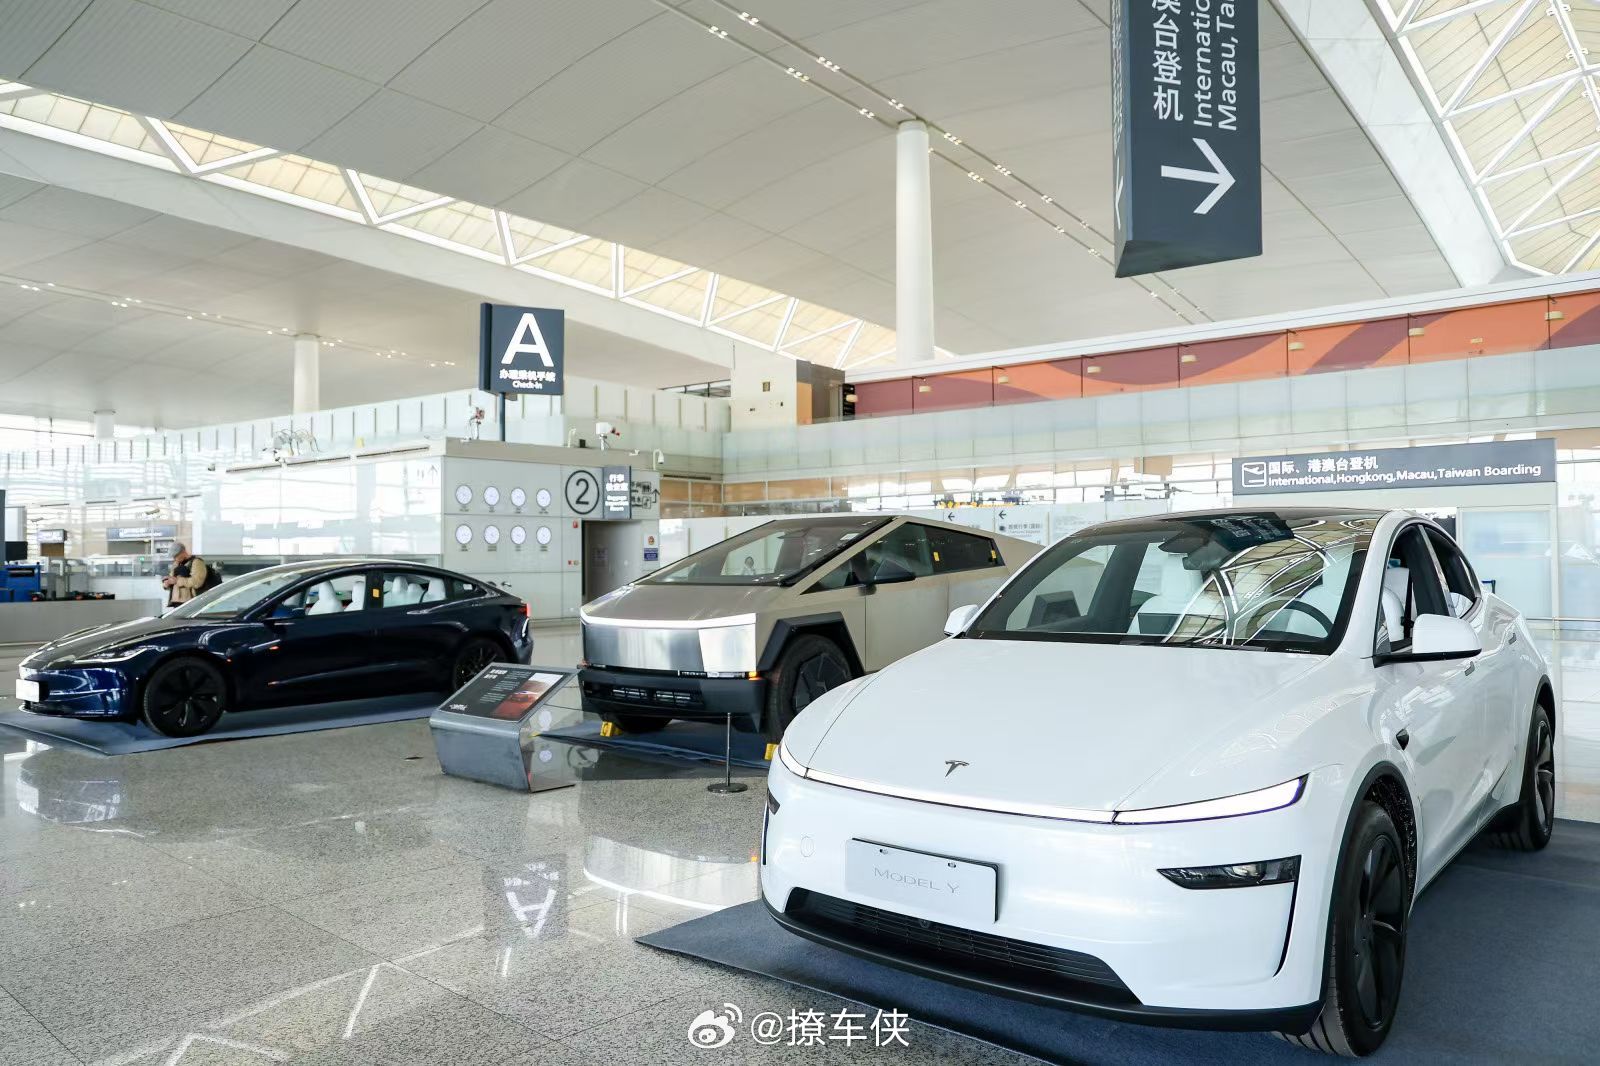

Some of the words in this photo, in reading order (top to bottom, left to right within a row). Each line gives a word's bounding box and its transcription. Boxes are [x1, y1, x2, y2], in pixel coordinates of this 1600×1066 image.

[501, 313, 554, 367] A
[1484, 464, 1542, 477] Boarding
[575, 478, 590, 505] 2
[874, 867, 941, 891] MODEL
[946, 882, 960, 894] Y
